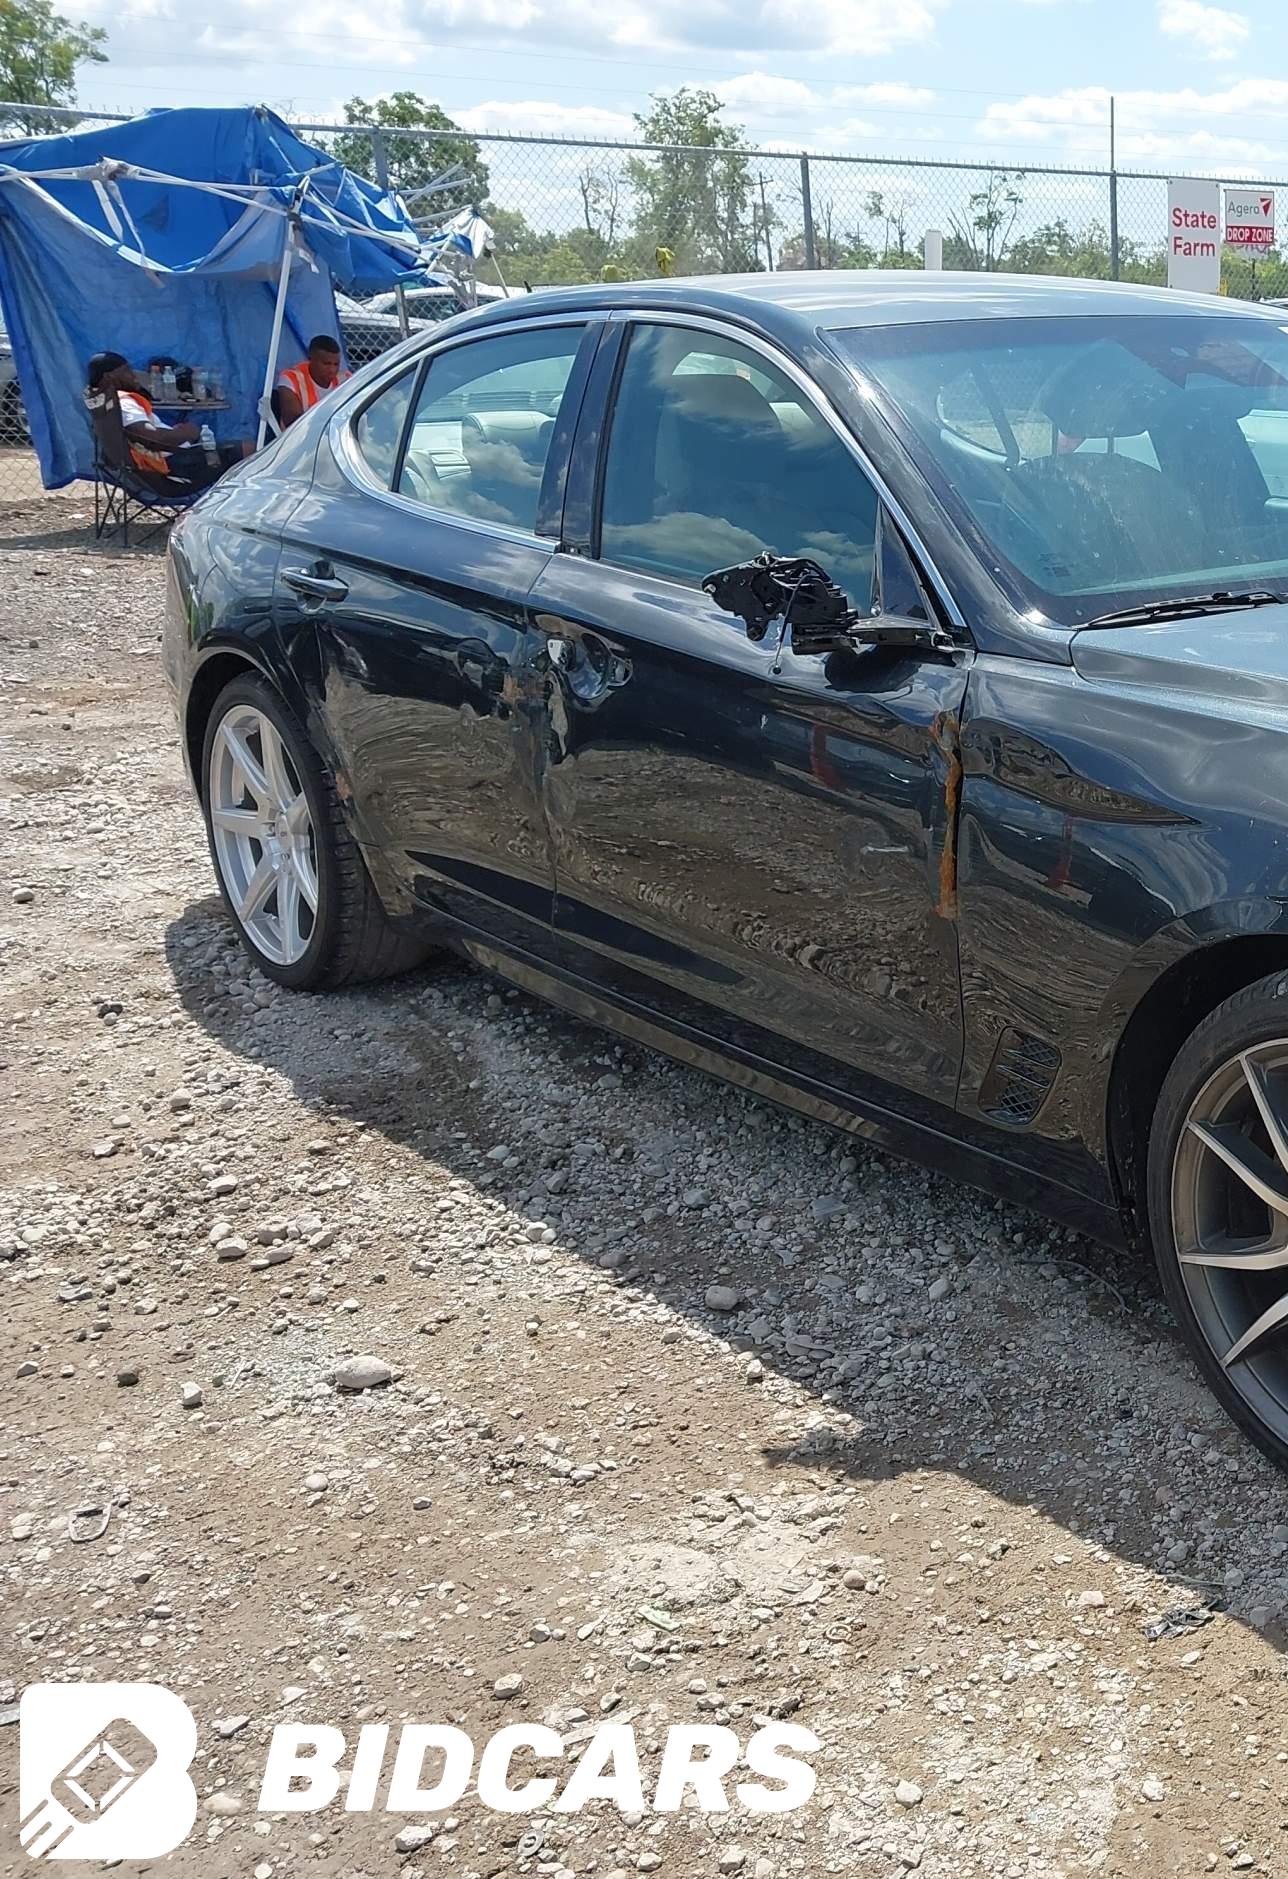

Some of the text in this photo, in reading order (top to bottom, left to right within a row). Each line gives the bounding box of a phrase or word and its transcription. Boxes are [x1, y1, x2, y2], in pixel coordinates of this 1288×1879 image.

[1227, 201, 1260, 217] Agero
[1172, 207, 1217, 230] State
[1227, 227, 1274, 242] DROP ZONE
[1173, 236, 1216, 257] Farm
